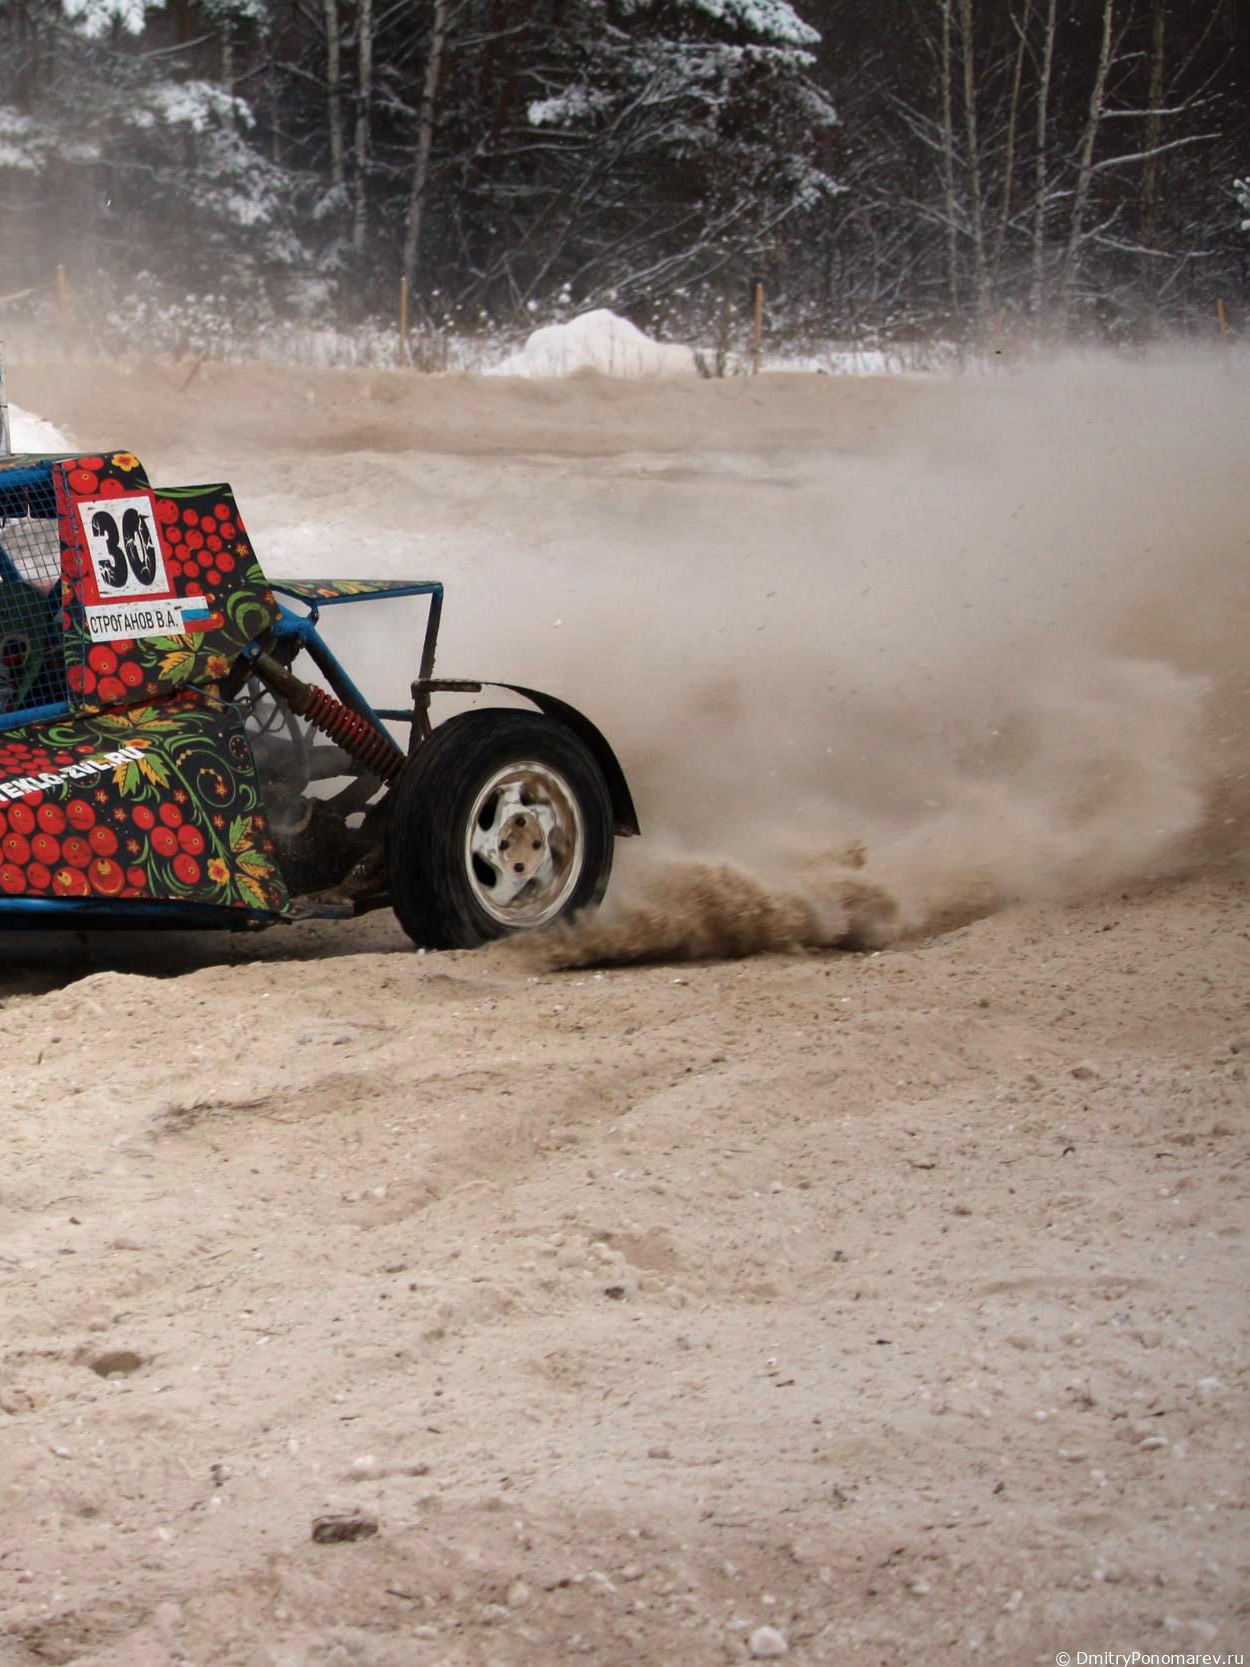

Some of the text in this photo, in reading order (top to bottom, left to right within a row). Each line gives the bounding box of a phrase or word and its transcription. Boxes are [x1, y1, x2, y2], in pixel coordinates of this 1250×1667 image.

[91, 508, 156, 588] 30
[90, 610, 179, 634] СТРОГАНОВ В.А.
